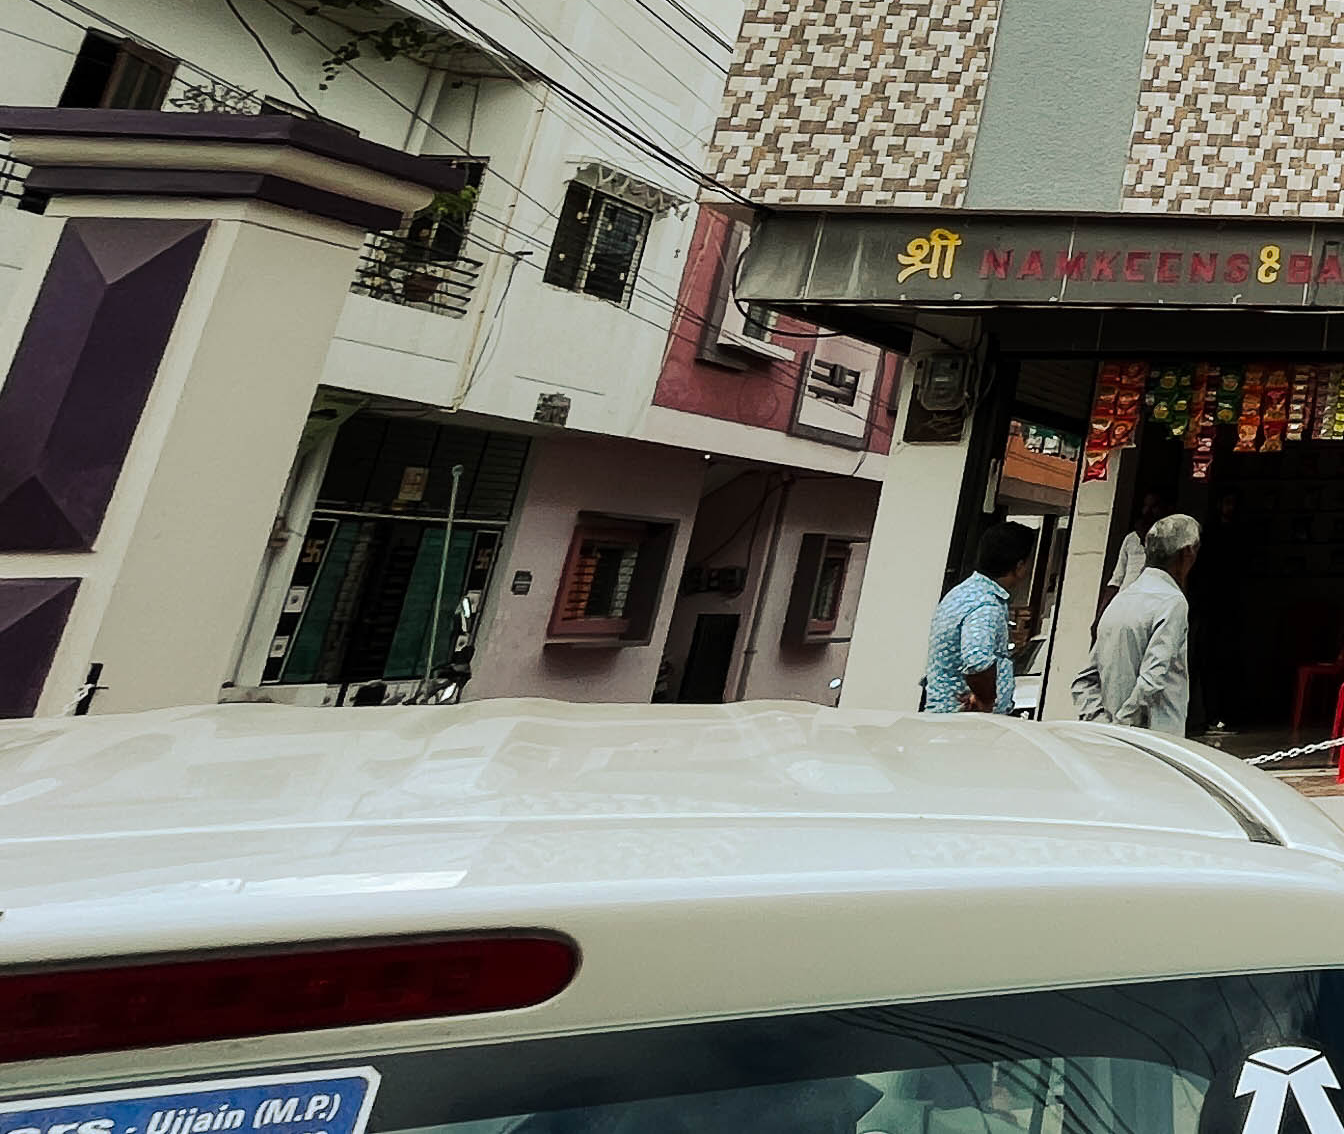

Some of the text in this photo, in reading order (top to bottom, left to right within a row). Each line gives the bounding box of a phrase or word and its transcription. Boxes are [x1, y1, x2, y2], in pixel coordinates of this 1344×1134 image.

[897, 228, 962, 284] श्री
[978, 248, 1250, 284] NAMKEENS
[252, 1093, 341, 1129] (M.P.)
